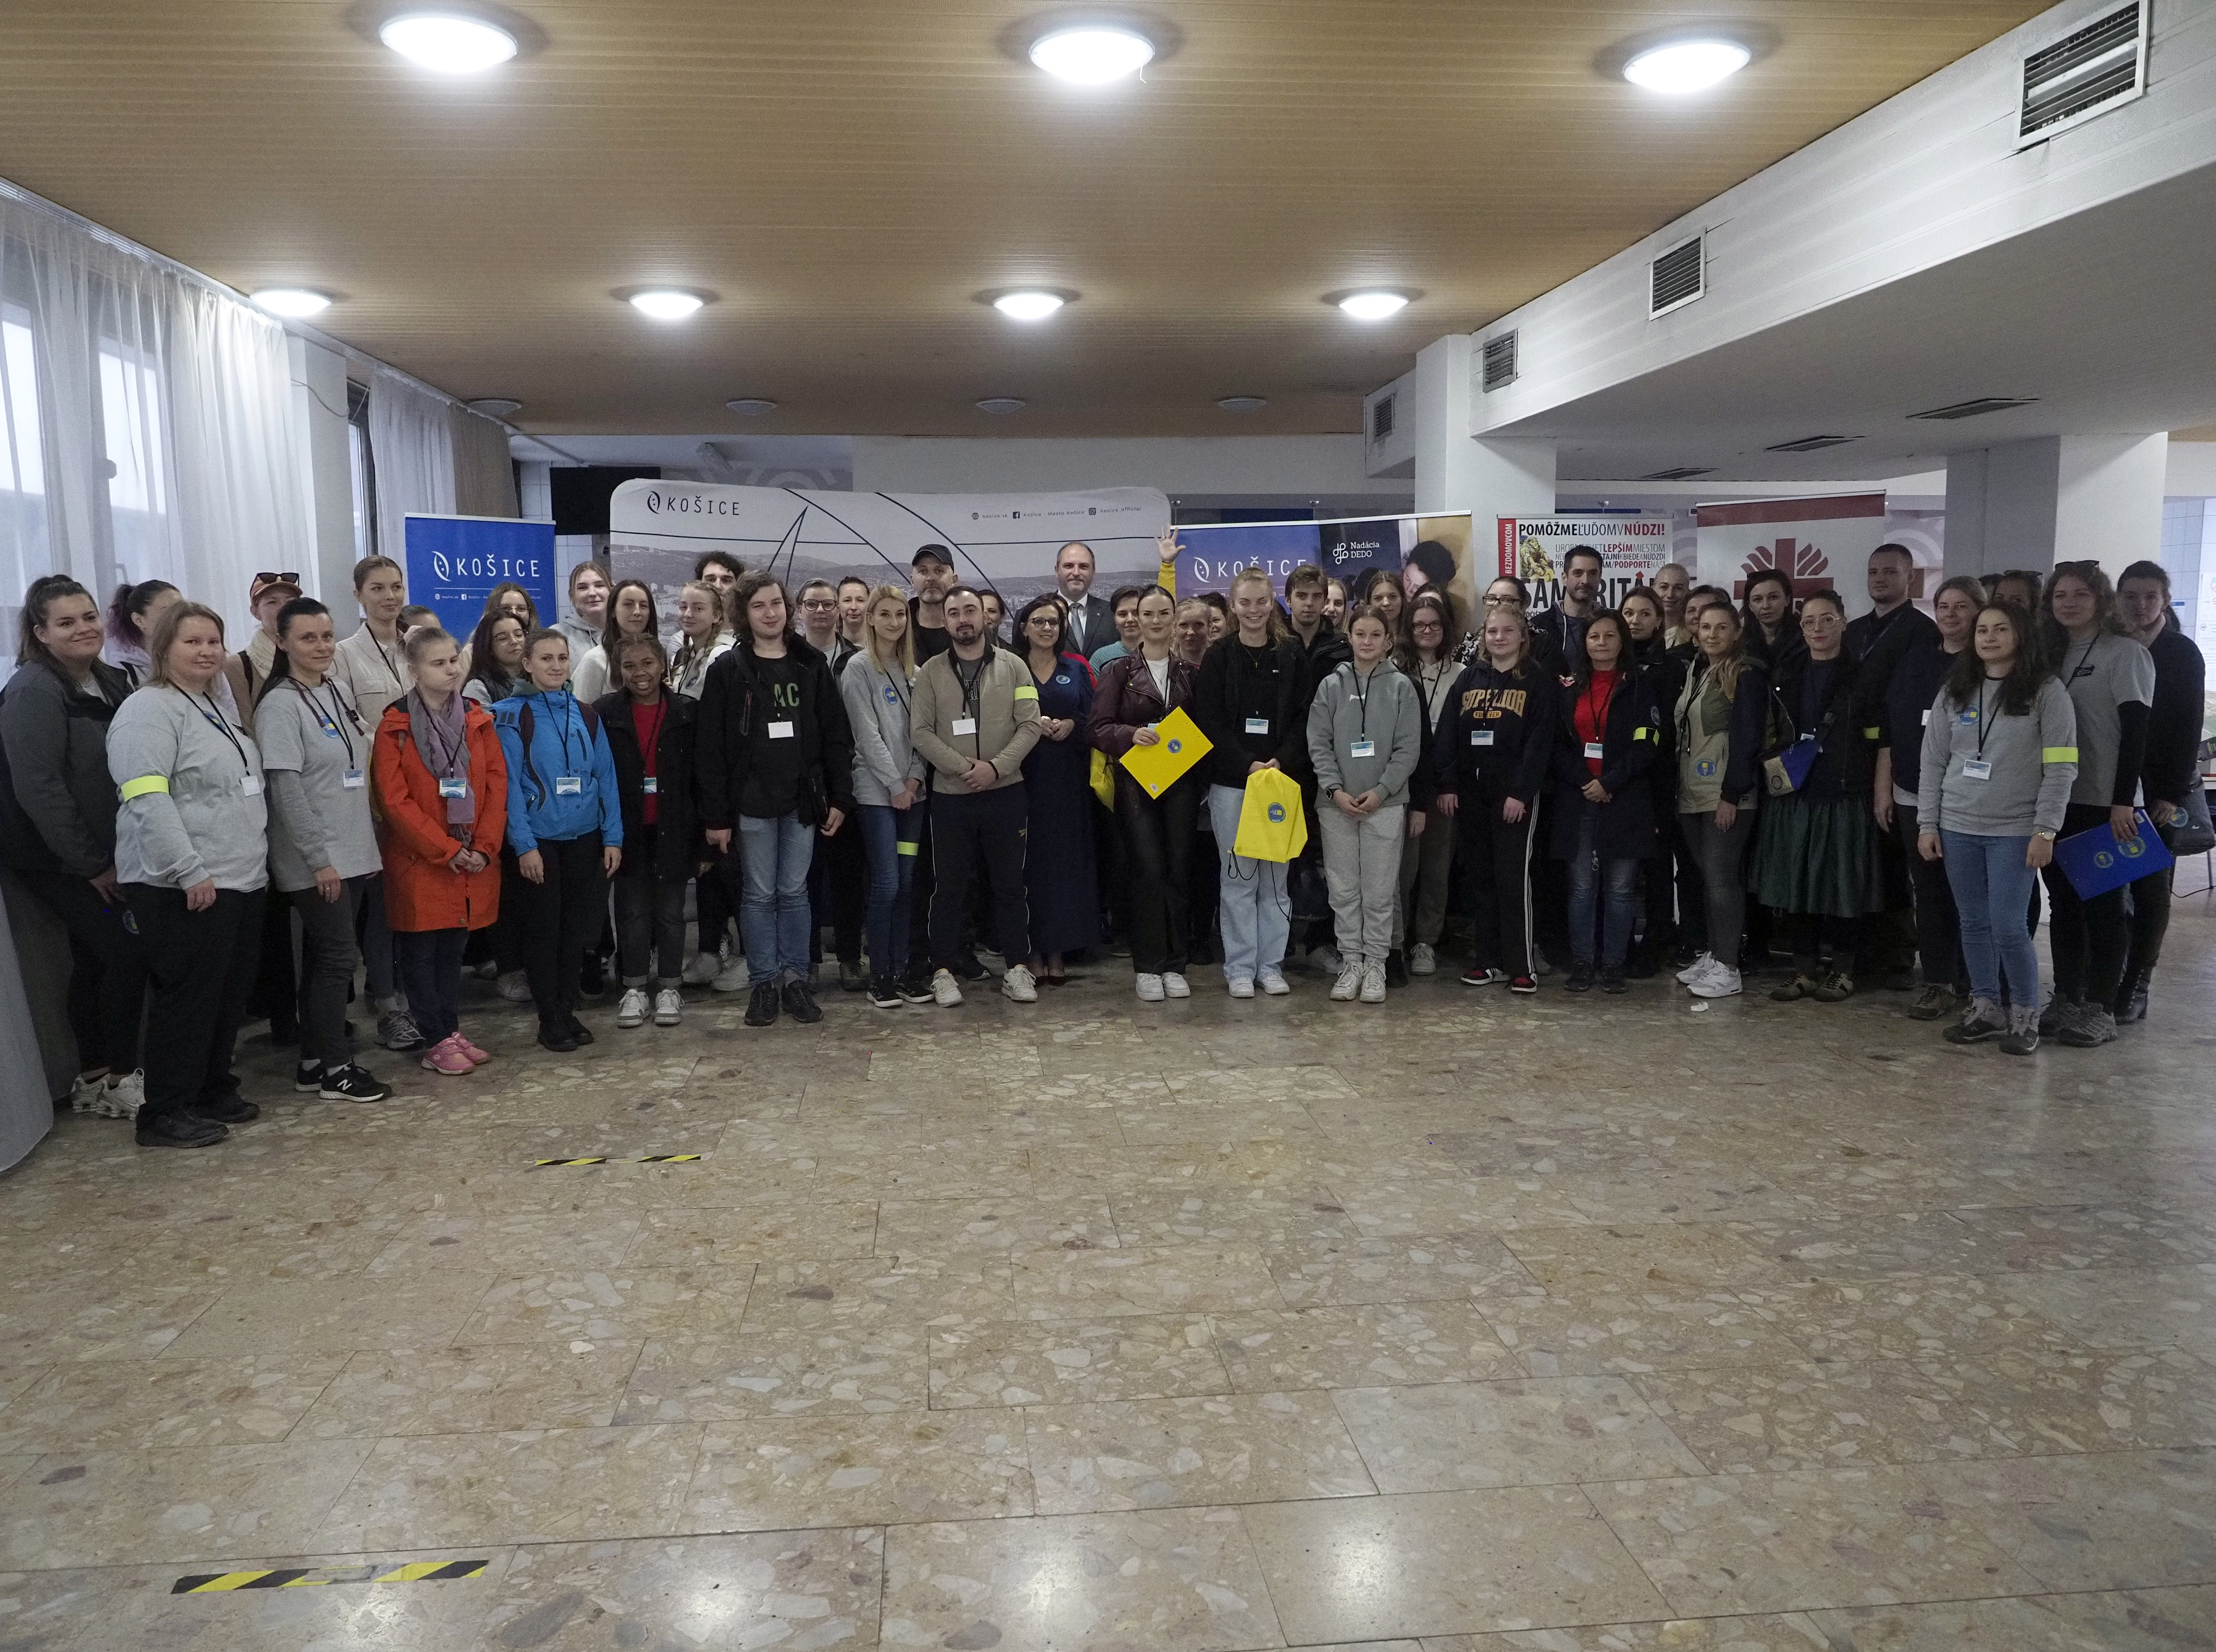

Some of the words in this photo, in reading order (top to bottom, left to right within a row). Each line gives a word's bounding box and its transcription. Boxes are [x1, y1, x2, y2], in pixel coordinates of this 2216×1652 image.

[668, 495, 740, 515] KOŠICE
[1350, 541, 1380, 549] Nadácia
[1351, 550, 1372, 558] DEDO
[457, 554, 540, 577] KOŠICE
